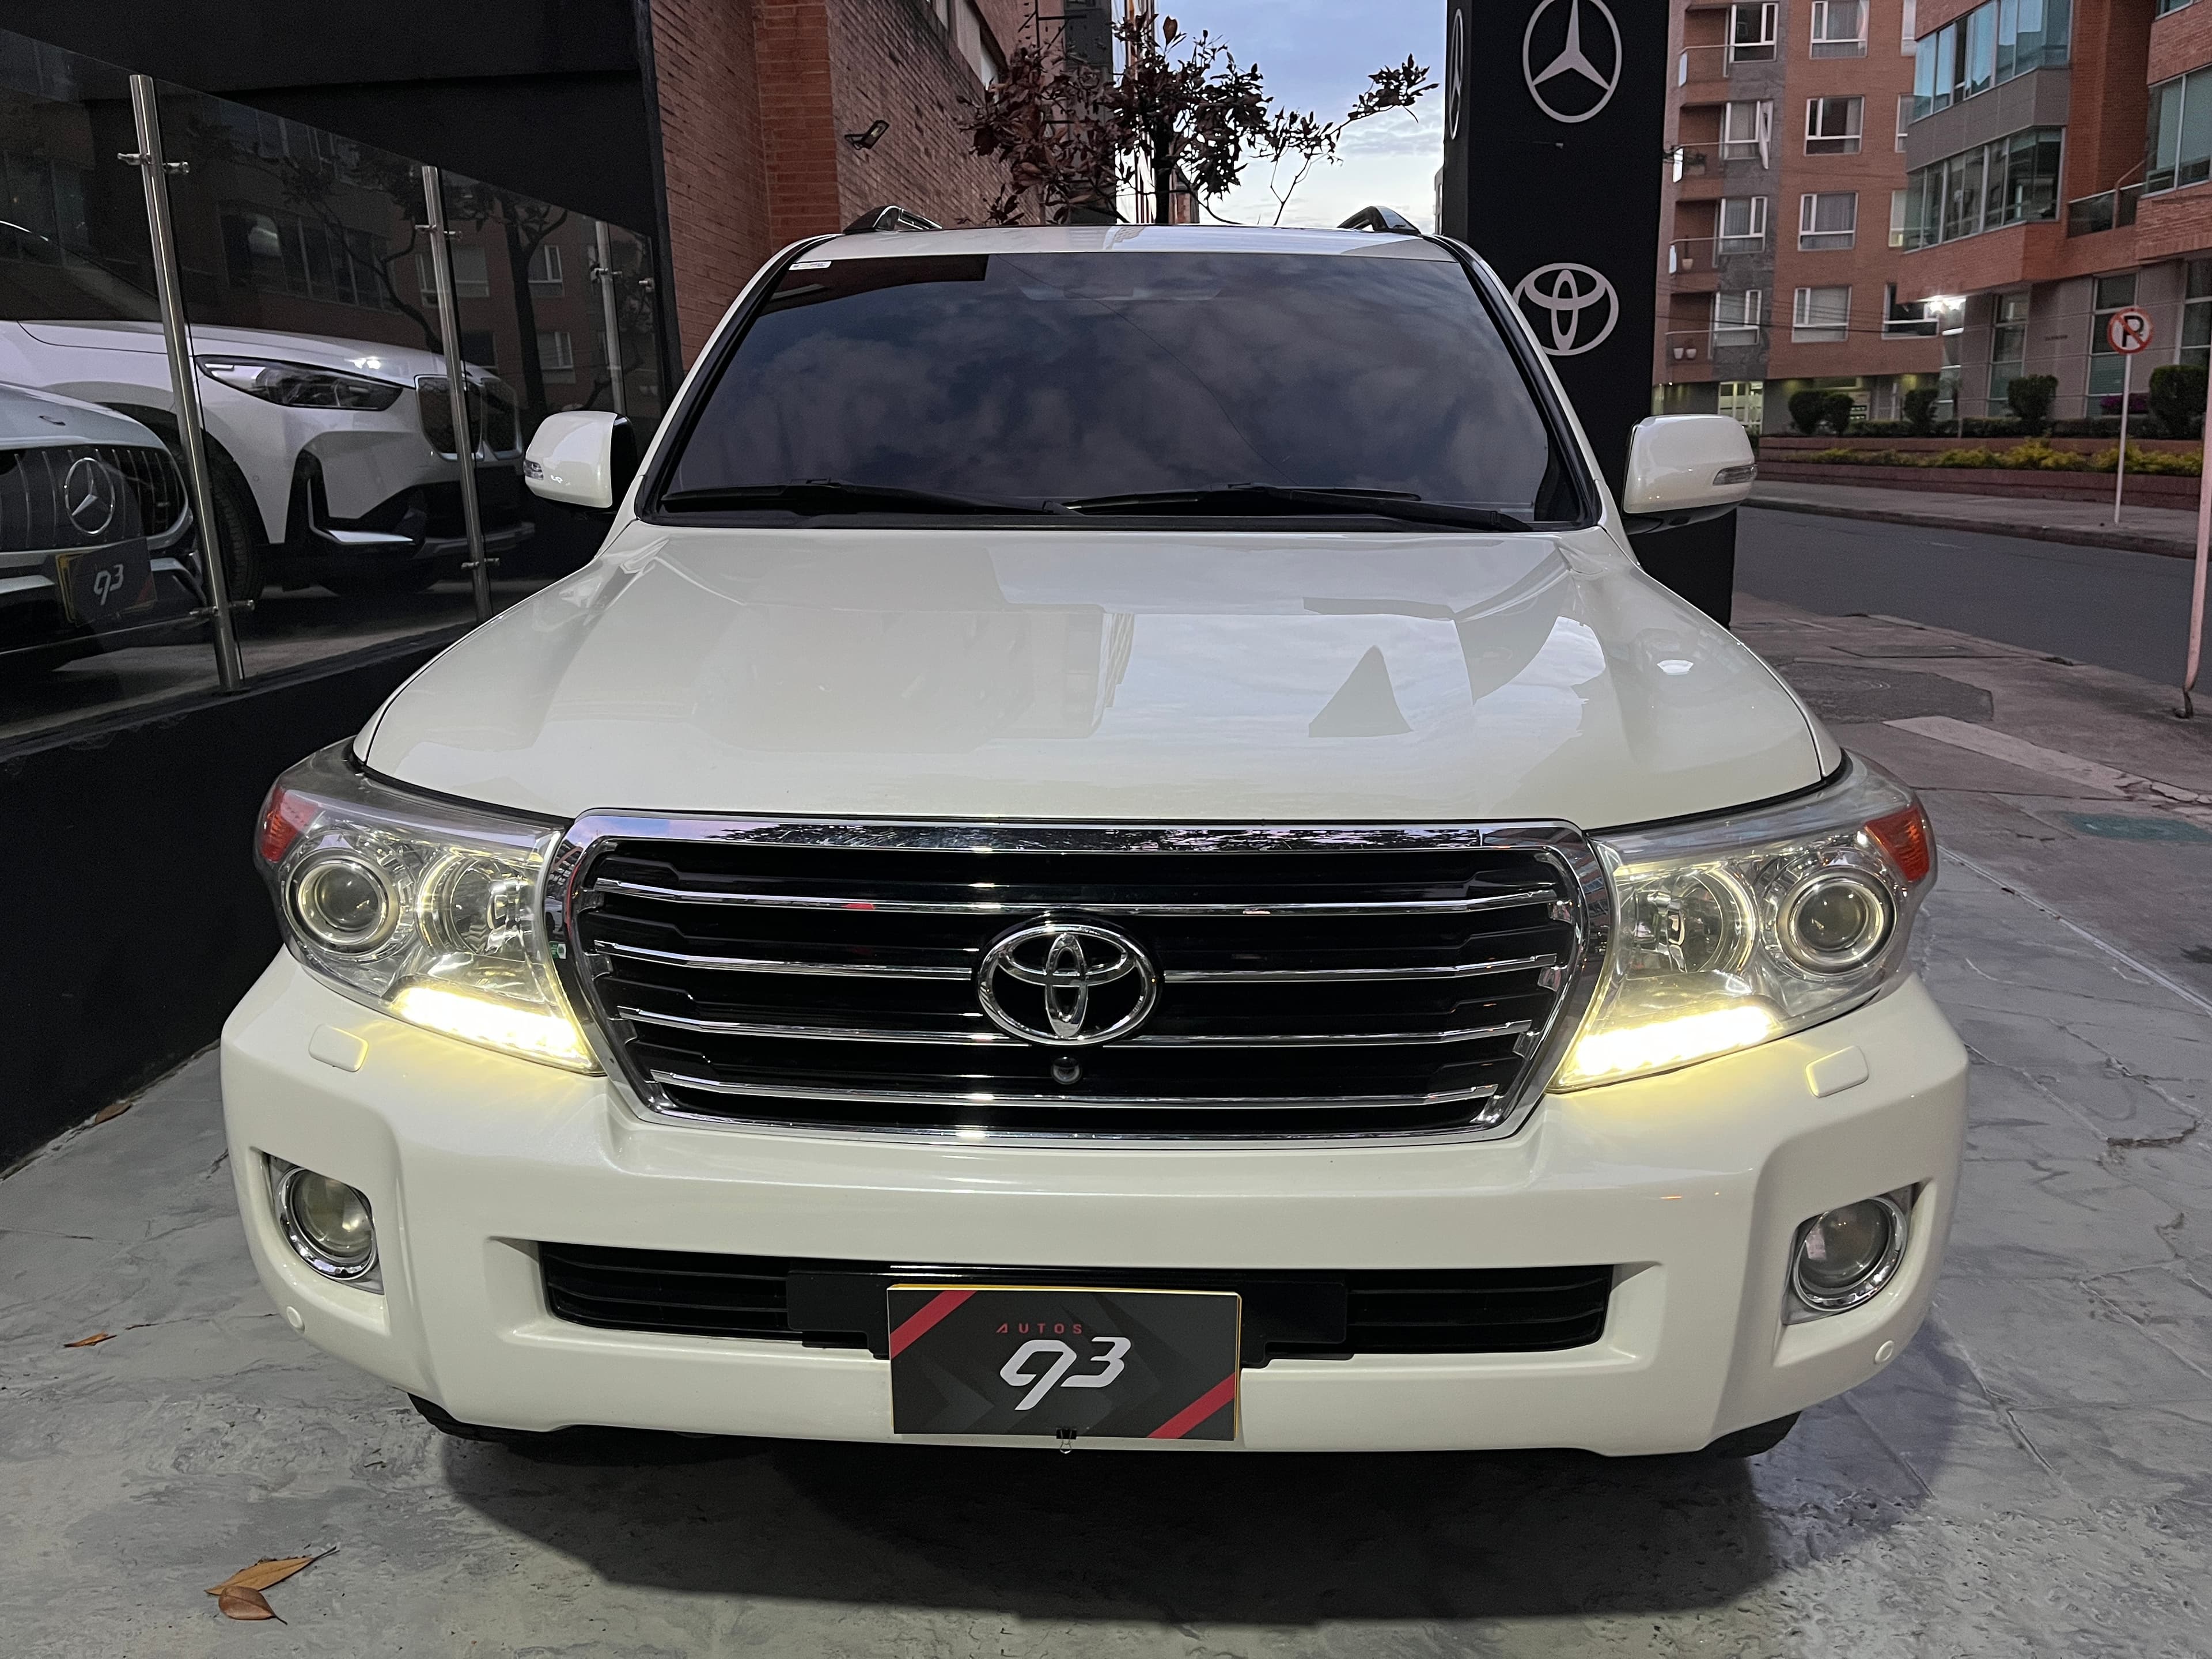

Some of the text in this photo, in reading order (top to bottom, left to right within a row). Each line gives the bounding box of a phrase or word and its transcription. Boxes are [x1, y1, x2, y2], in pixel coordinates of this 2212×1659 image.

[2122, 315, 2144, 347] P
[93, 563, 124, 605] 93
[995, 1323, 1083, 1334] AUTOS
[999, 1336, 1131, 1411] 93
